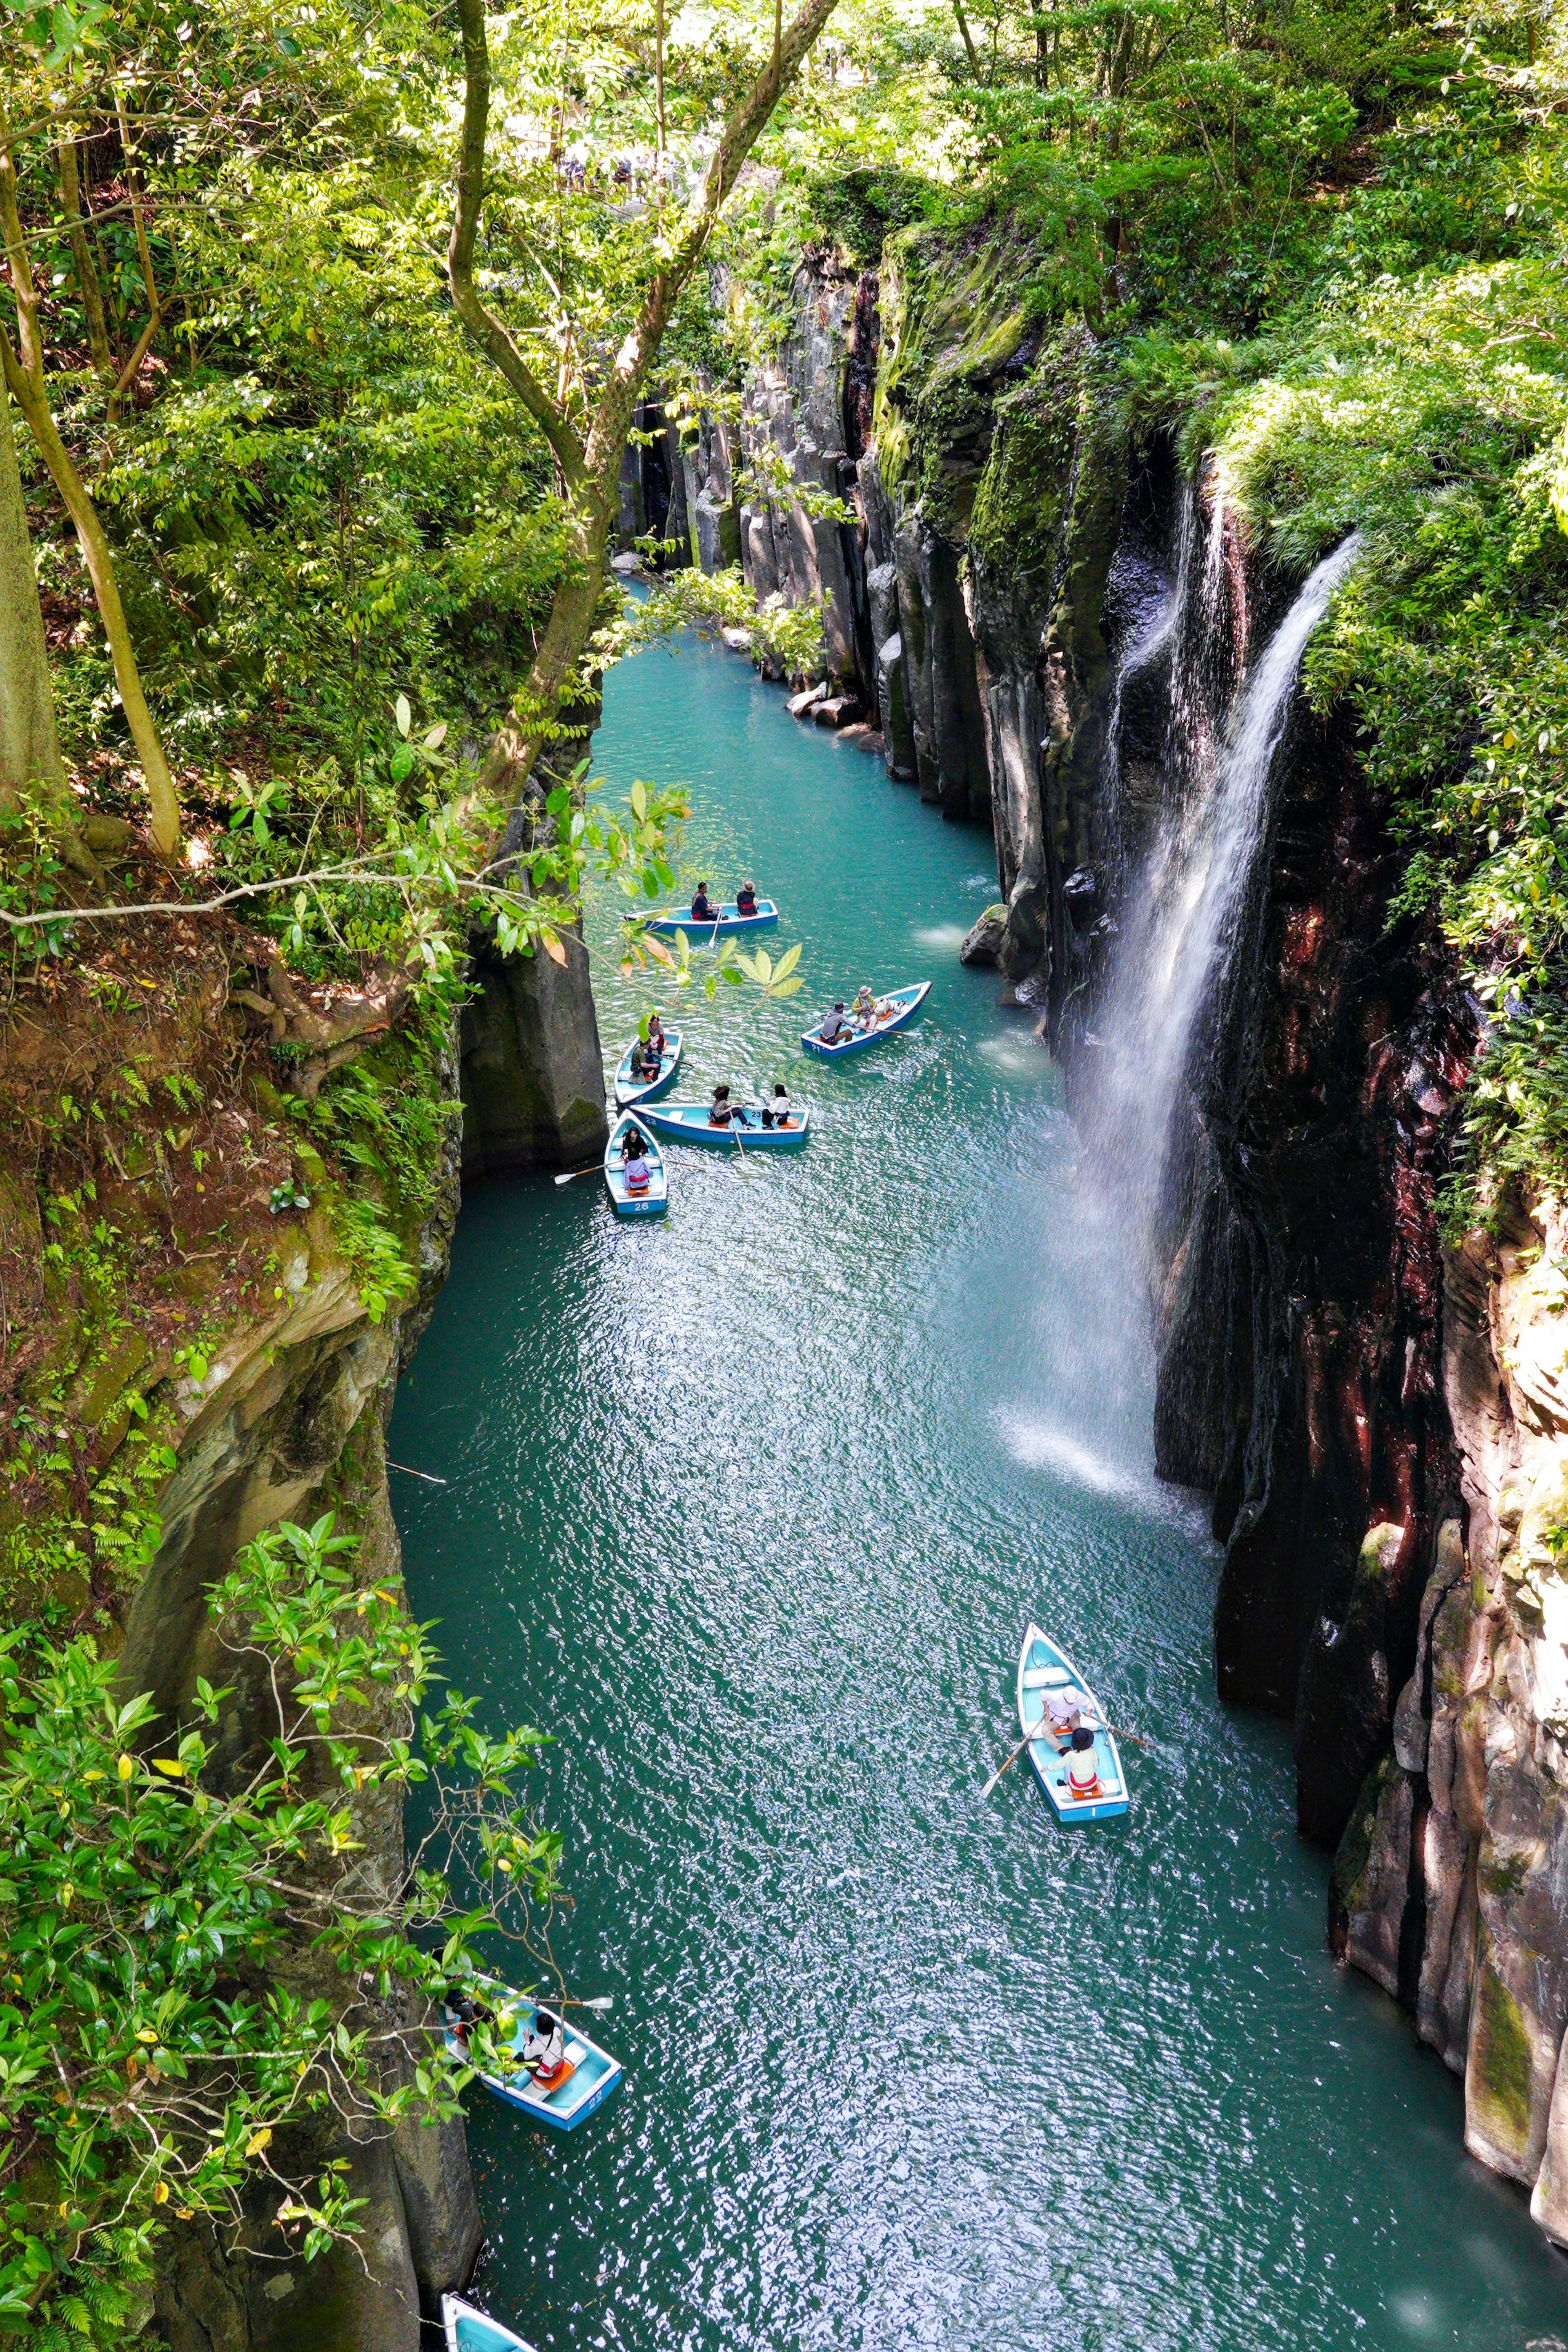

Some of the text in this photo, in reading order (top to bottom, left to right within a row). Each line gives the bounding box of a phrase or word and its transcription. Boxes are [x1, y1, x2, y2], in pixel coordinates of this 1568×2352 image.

[812, 1044, 820, 1054] 21
[646, 1117, 656, 1125] 23
[635, 1202, 649, 1212] 26
